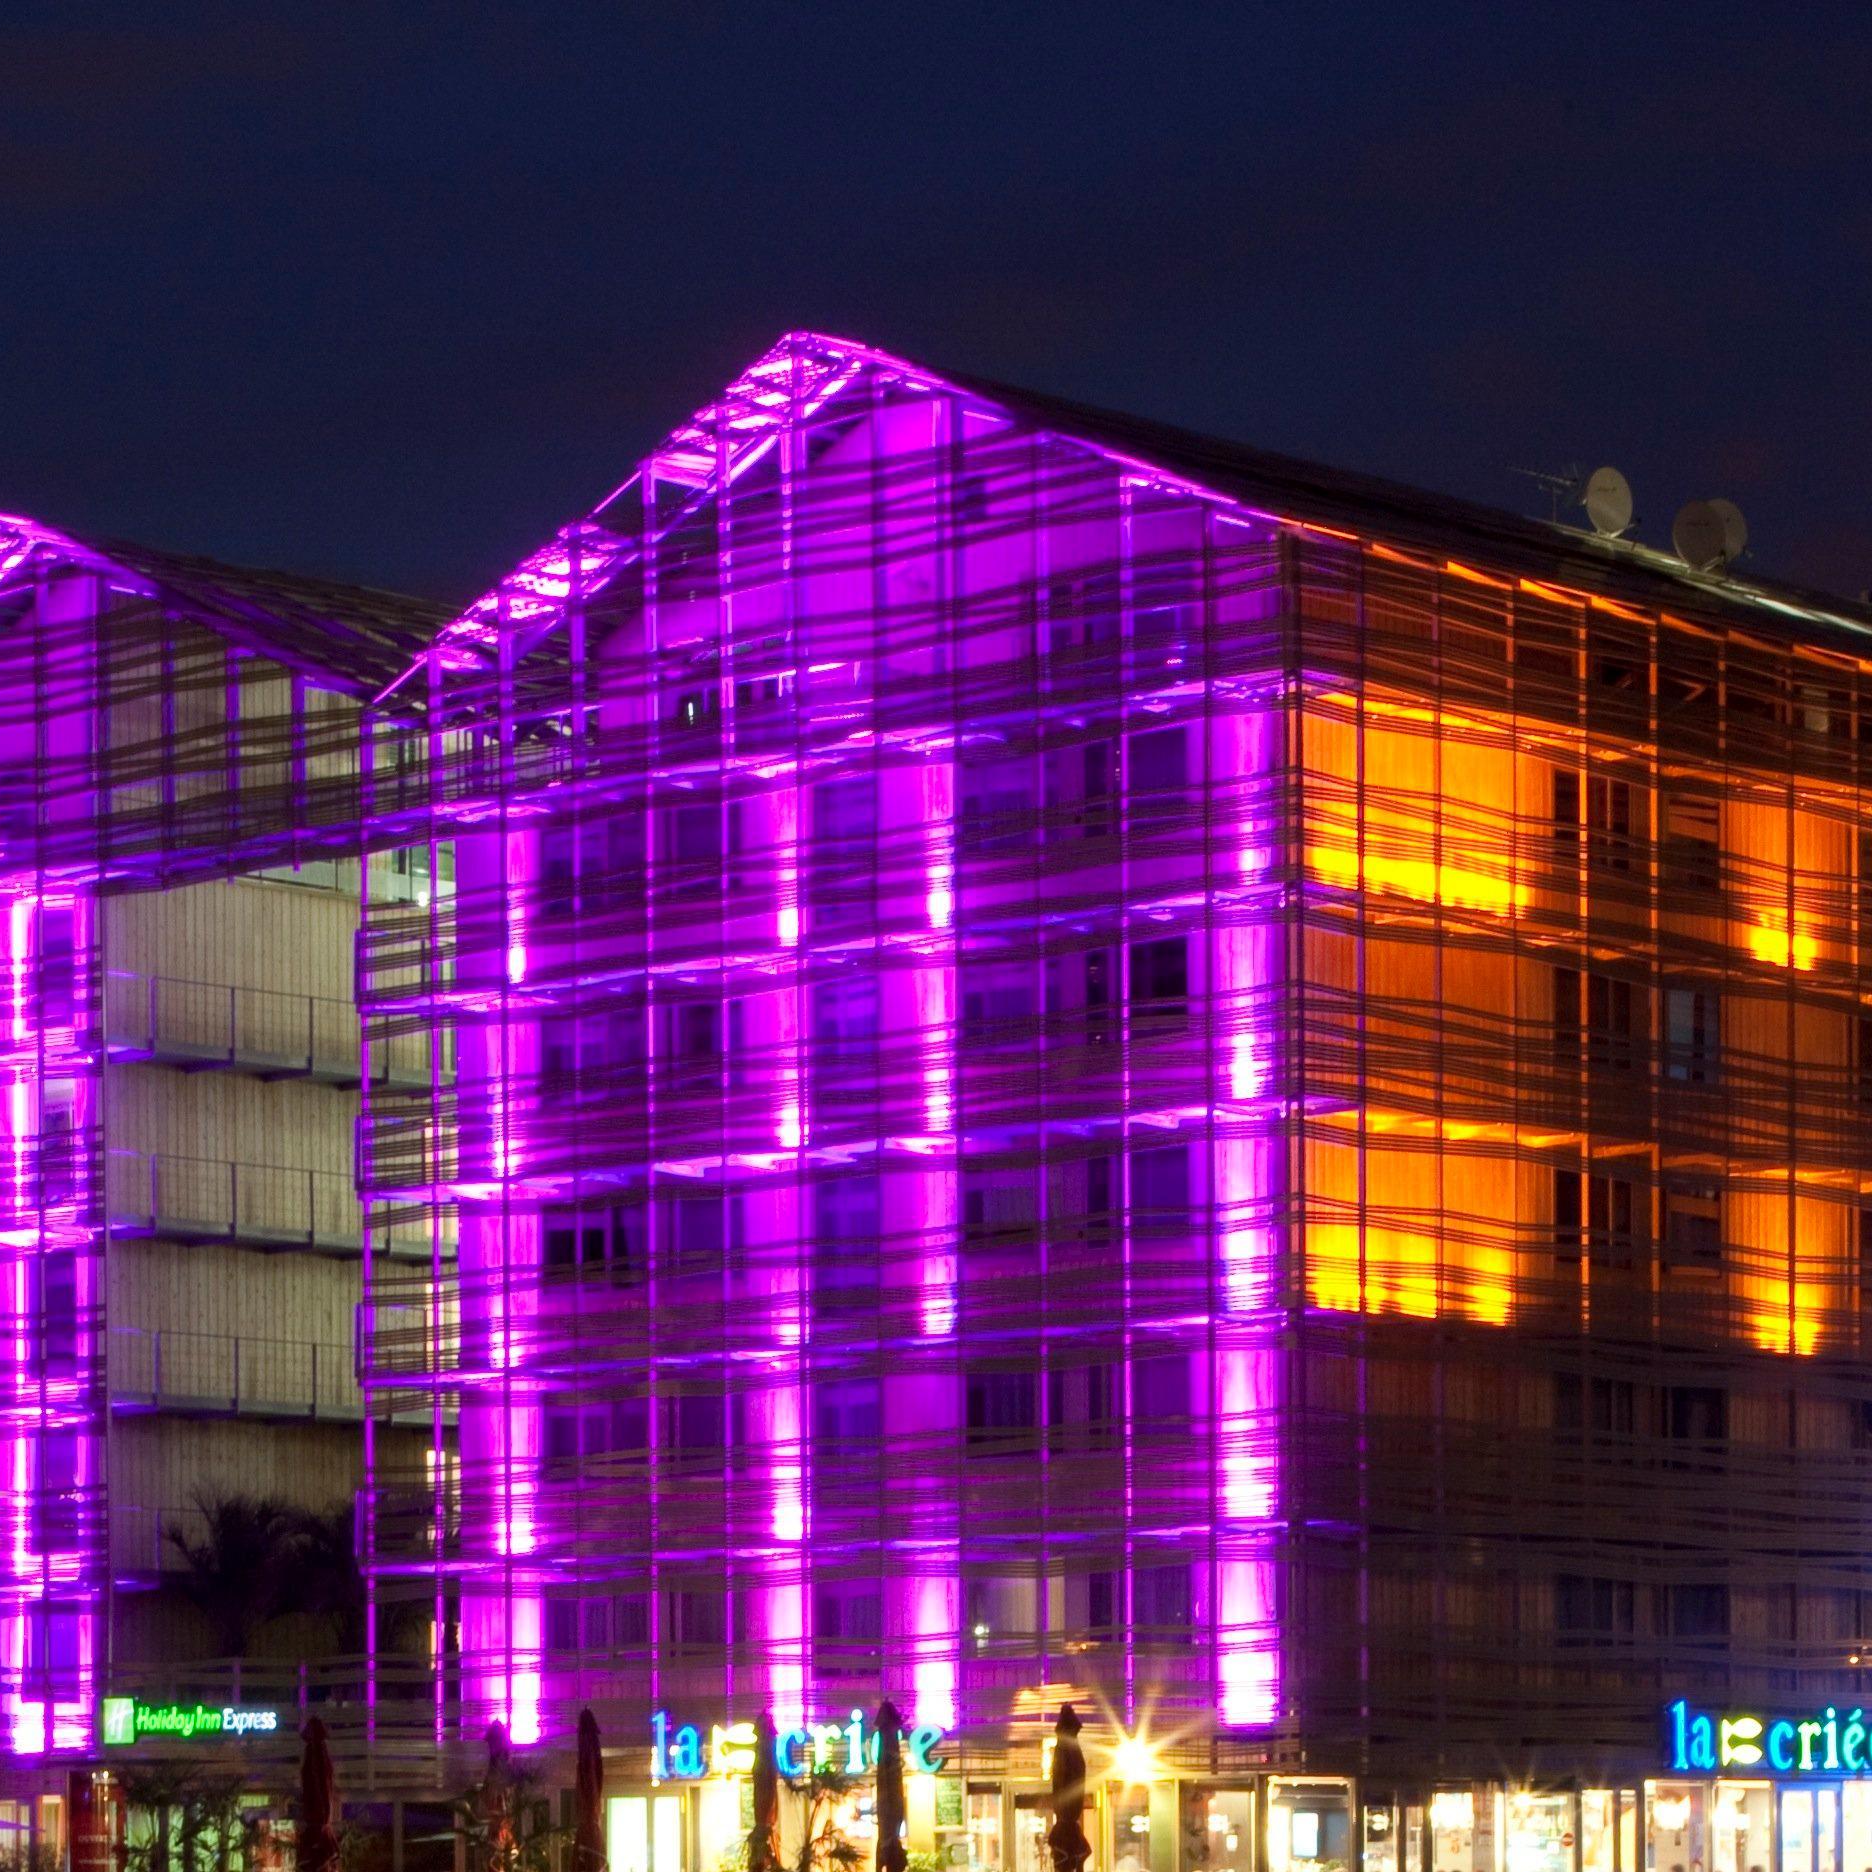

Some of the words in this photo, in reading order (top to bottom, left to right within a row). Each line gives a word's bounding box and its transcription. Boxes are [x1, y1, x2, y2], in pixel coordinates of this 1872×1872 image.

[136, 1705, 195, 1737] Holiday
[196, 1705, 222, 1729] Inn
[222, 1707, 277, 1736] Express
[651, 1709, 705, 1779] la
[1672, 1700, 1716, 1770] la
